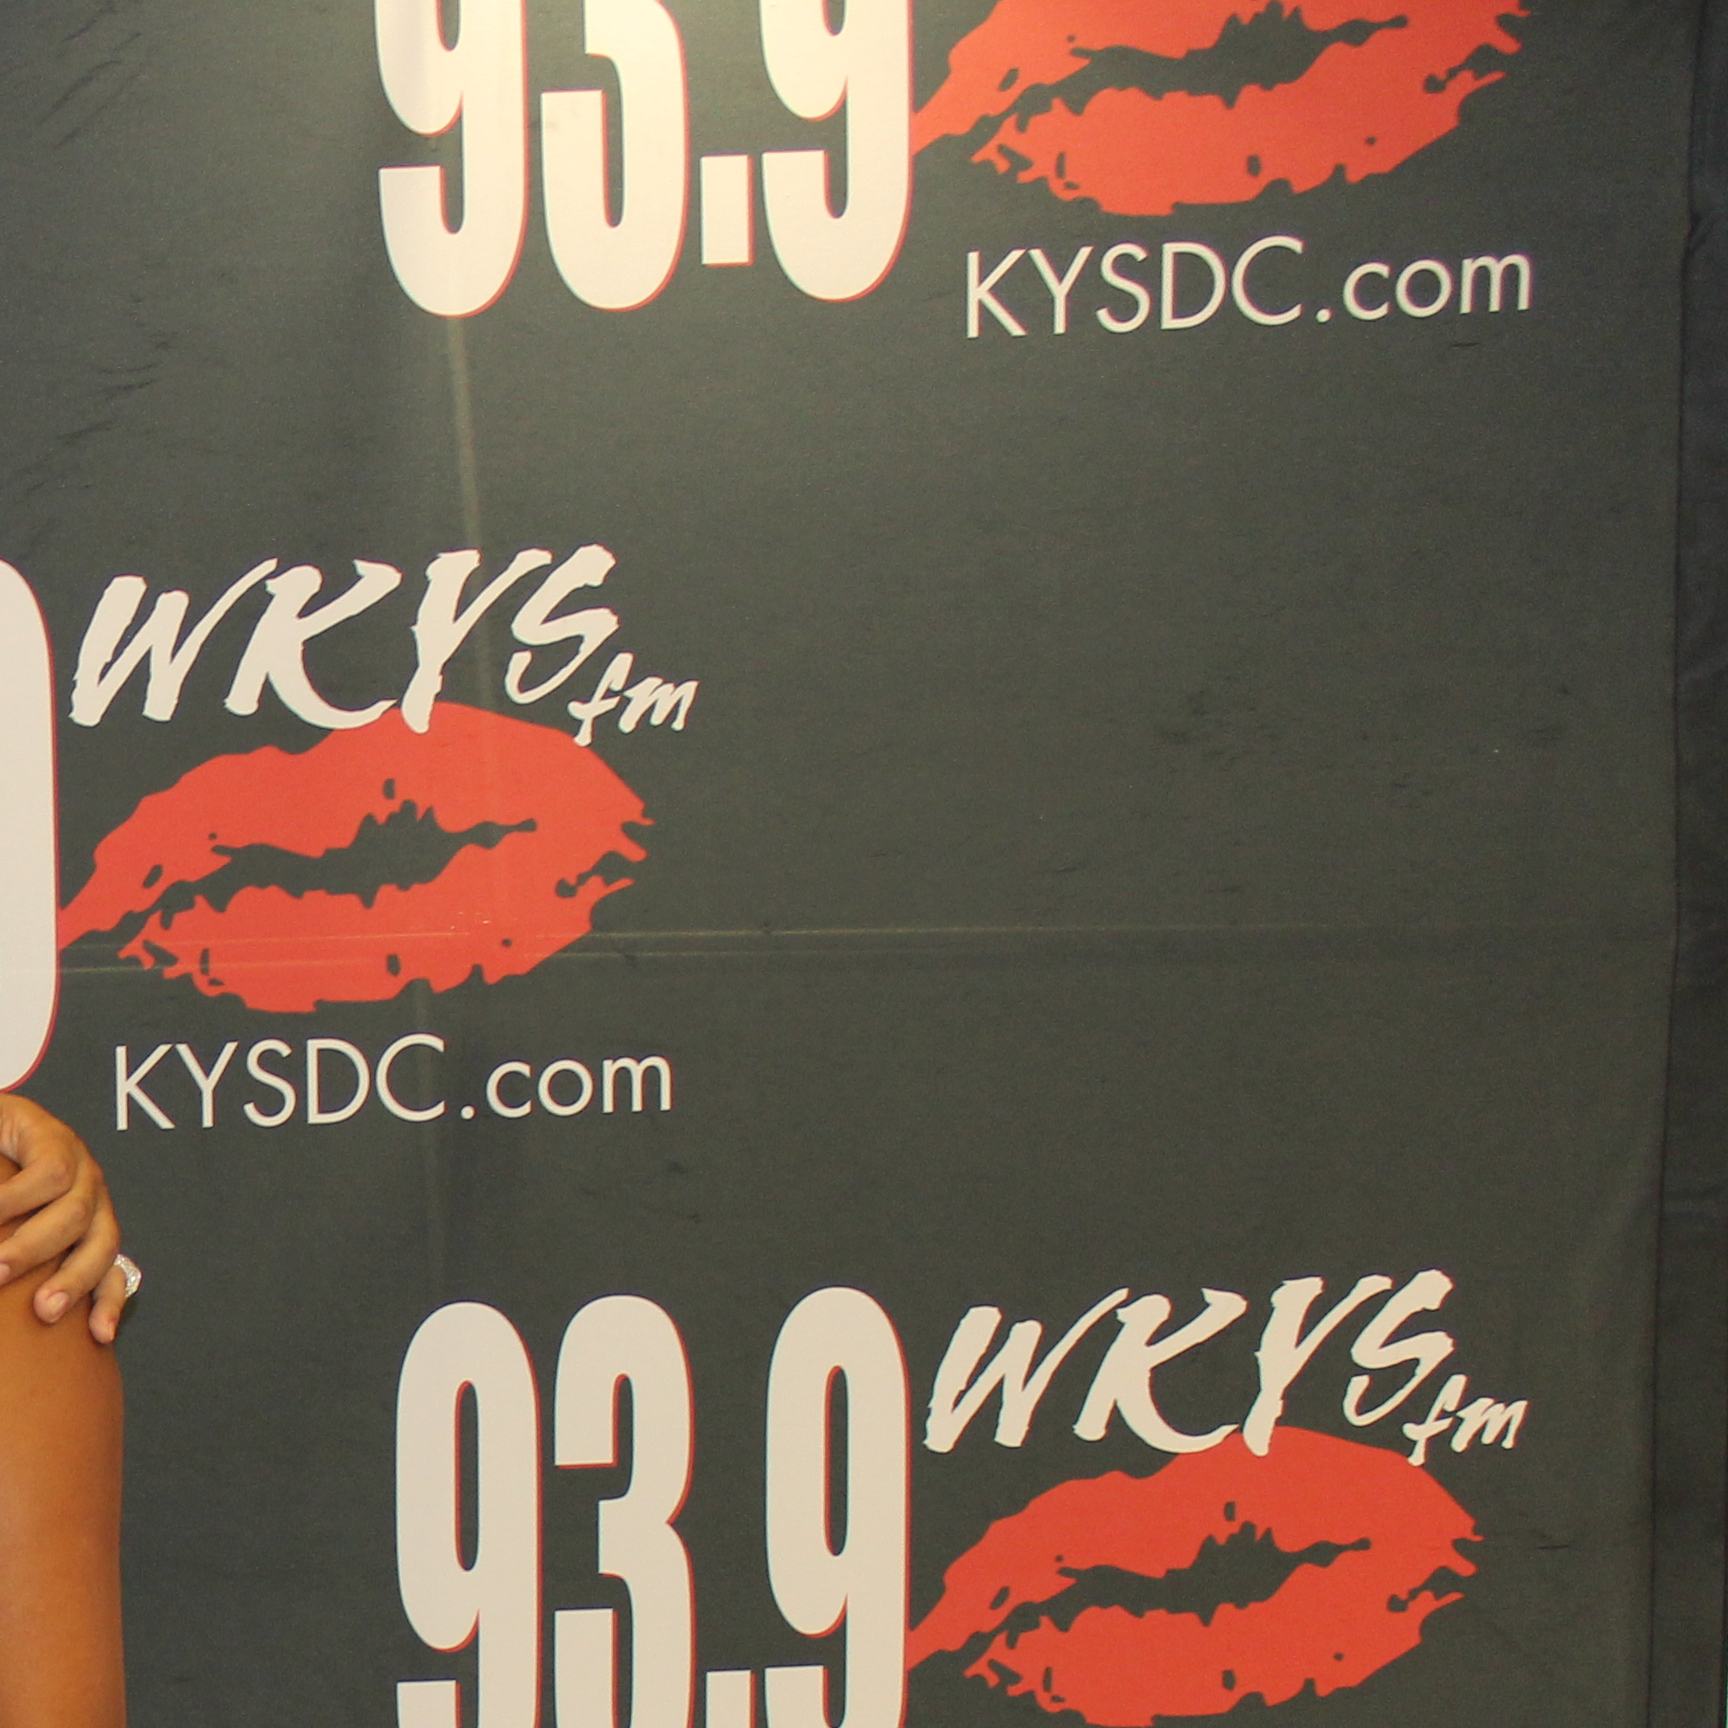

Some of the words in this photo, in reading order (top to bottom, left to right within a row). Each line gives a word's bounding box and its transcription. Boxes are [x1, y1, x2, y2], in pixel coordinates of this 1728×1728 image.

[373, 0, 913, 317] 93.9
[966, 235, 1531, 339] KYSDC.com
[68, 543, 619, 734] WKYS
[567, 652, 699, 747] fm
[115, 1033, 671, 1131] KYSDC.com
[923, 1269, 1454, 1456] WKYS
[1402, 1374, 1528, 1467] fm
